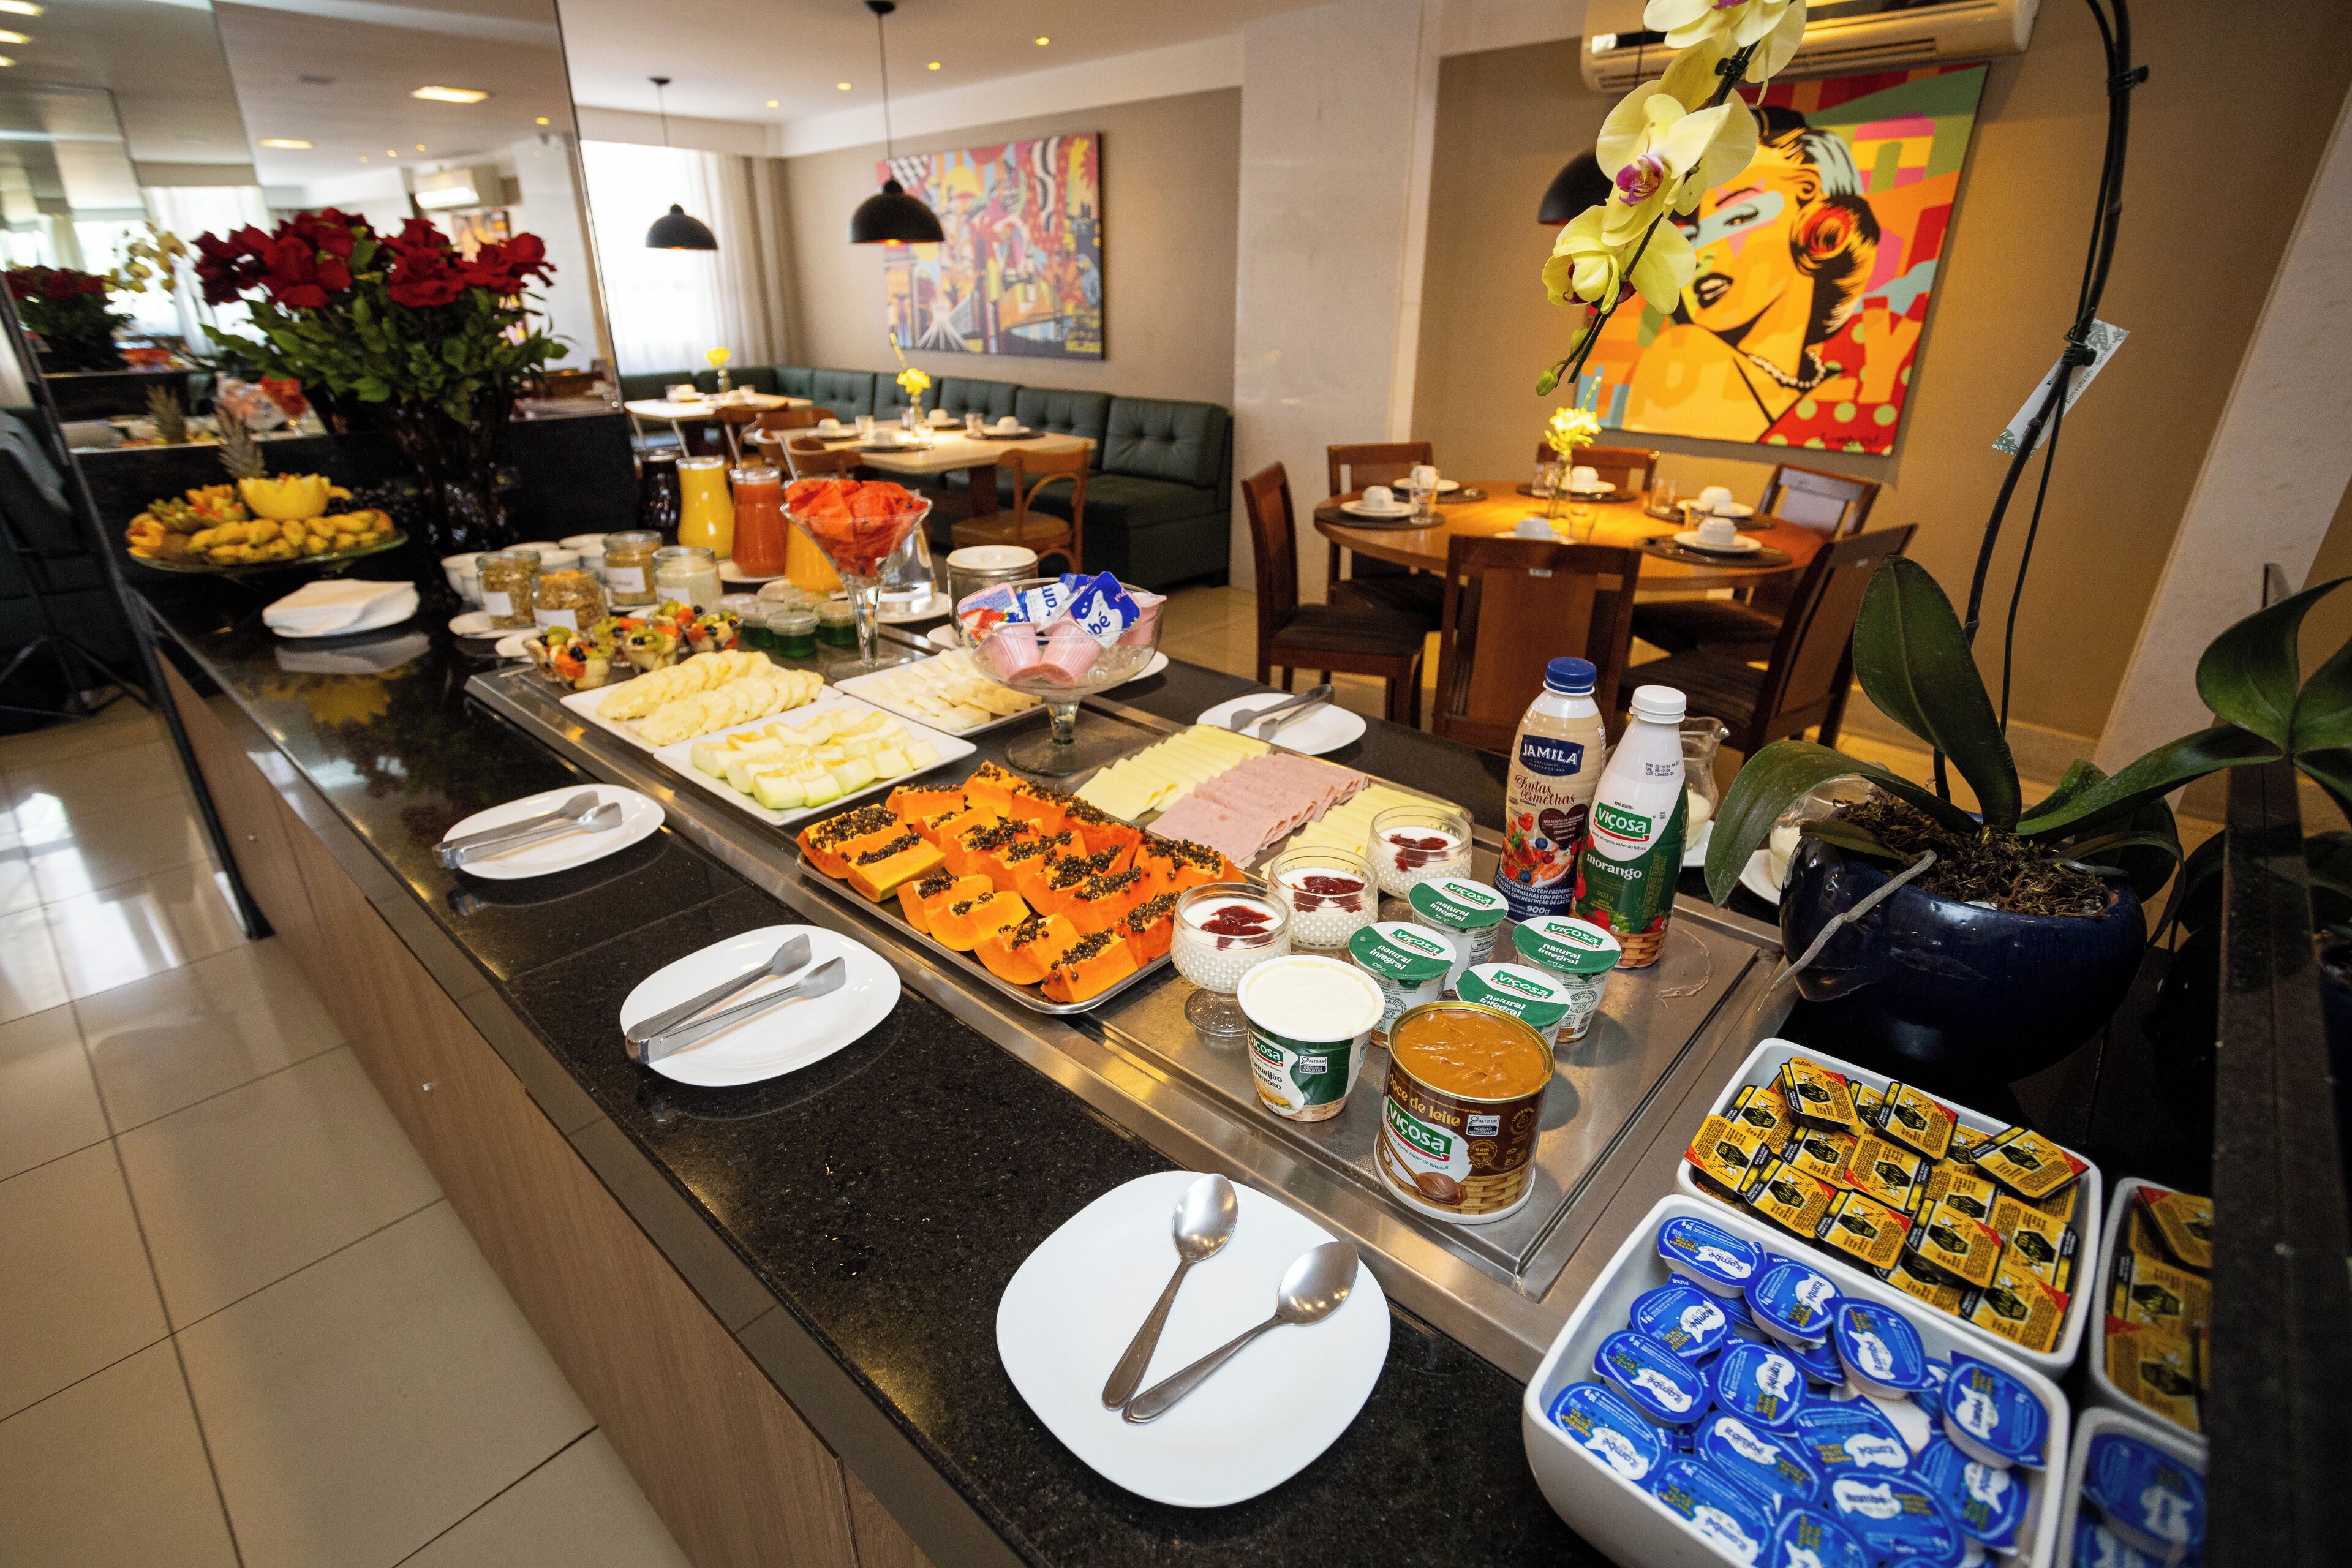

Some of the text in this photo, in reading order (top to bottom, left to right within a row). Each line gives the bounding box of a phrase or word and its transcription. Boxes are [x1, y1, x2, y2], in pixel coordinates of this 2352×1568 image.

[1523, 744, 1578, 765] JAMILA
[1515, 775, 1551, 796] Frutas
[1521, 789, 1575, 805] vermelhas
[1586, 853, 1643, 880] morango
[1509, 881, 1536, 892] DESNATADO
[1511, 887, 1539, 899] VERMELHAS
[1436, 901, 1470, 916] natural
[1521, 895, 1549, 905] RESTRIÇÃO
[1430, 903, 1467, 921] integral
[1526, 905, 1550, 915] 900g
[1369, 948, 1406, 970] integral
[1378, 944, 1412, 963] natural
[1537, 947, 1579, 965] integral
[1542, 943, 1581, 959] natural
[1479, 998, 1523, 1017] integral
[1485, 993, 1526, 1010] natural
[1253, 1068, 1281, 1090] cremoso
[1389, 1074, 1461, 1126] doce de leite
[1923, 1101, 1932, 1111] 15g
[1409, 1152, 1422, 1161] saber
[1707, 1160, 1717, 1170] 15g
[1804, 1180, 1814, 1189] 15g
[1790, 1193, 1802, 1206] MEL
[1668, 1237, 1698, 1256] MANTEIGA
[1749, 1241, 1761, 1254] PUXE
[1706, 1250, 1744, 1275] itambé
[1806, 1280, 1825, 1304] itambé
[1689, 1307, 1716, 1331] itambé
[1668, 1332, 1684, 1344] EXTRA
[1669, 1333, 1692, 1350] MANTEIGA
[1644, 1375, 1683, 1404] itambé
[1561, 1412, 1591, 1439] MANTEIGA
[1569, 1412, 1589, 1430] EXTRA
[1600, 1436, 1638, 1469] itambé
